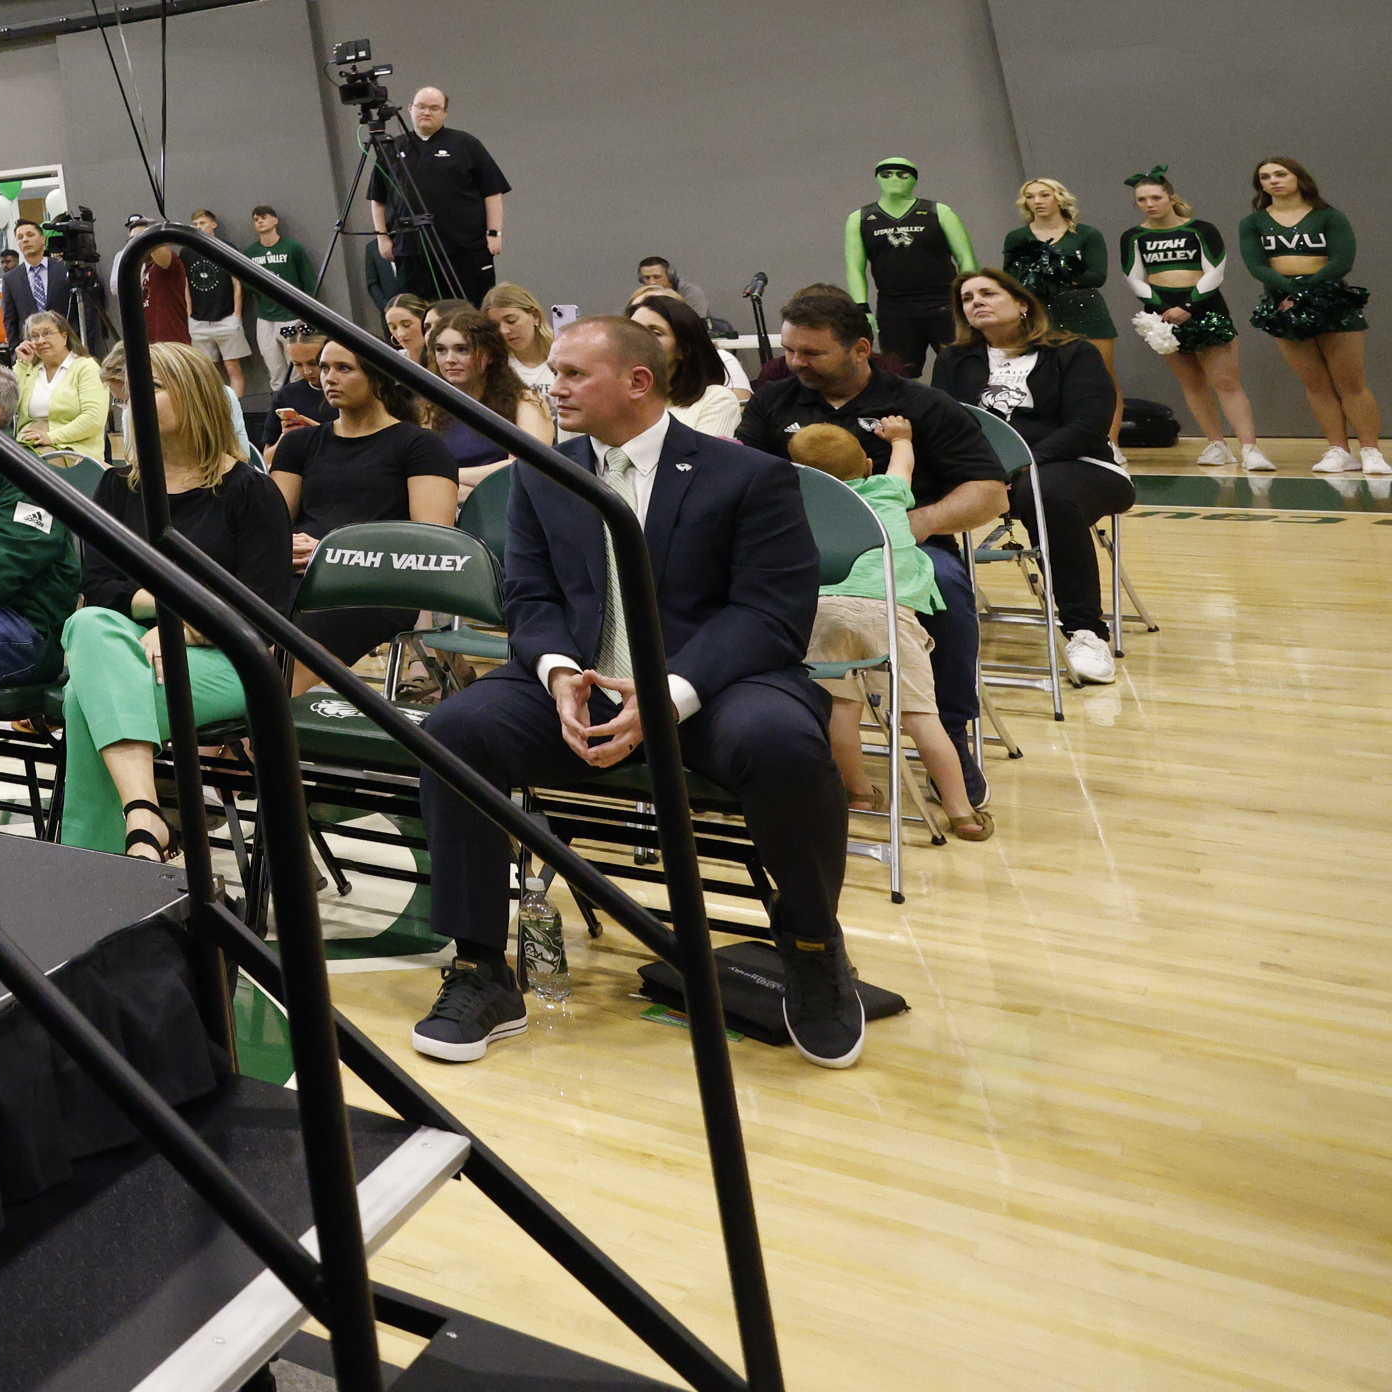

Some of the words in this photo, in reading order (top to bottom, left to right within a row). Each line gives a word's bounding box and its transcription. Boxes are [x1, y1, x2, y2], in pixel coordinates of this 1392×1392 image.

[873, 227, 895, 236] UTAH
[895, 226, 926, 234] VALLEY
[1145, 237, 1187, 251] UTAH
[1261, 233, 1327, 250] UVU
[267, 254, 288, 264] VALLEY
[1143, 249, 1198, 263] VALLEY
[23, 515, 45, 528] adidas
[325, 548, 384, 568] UTAH
[390, 553, 472, 572] VALLEY
